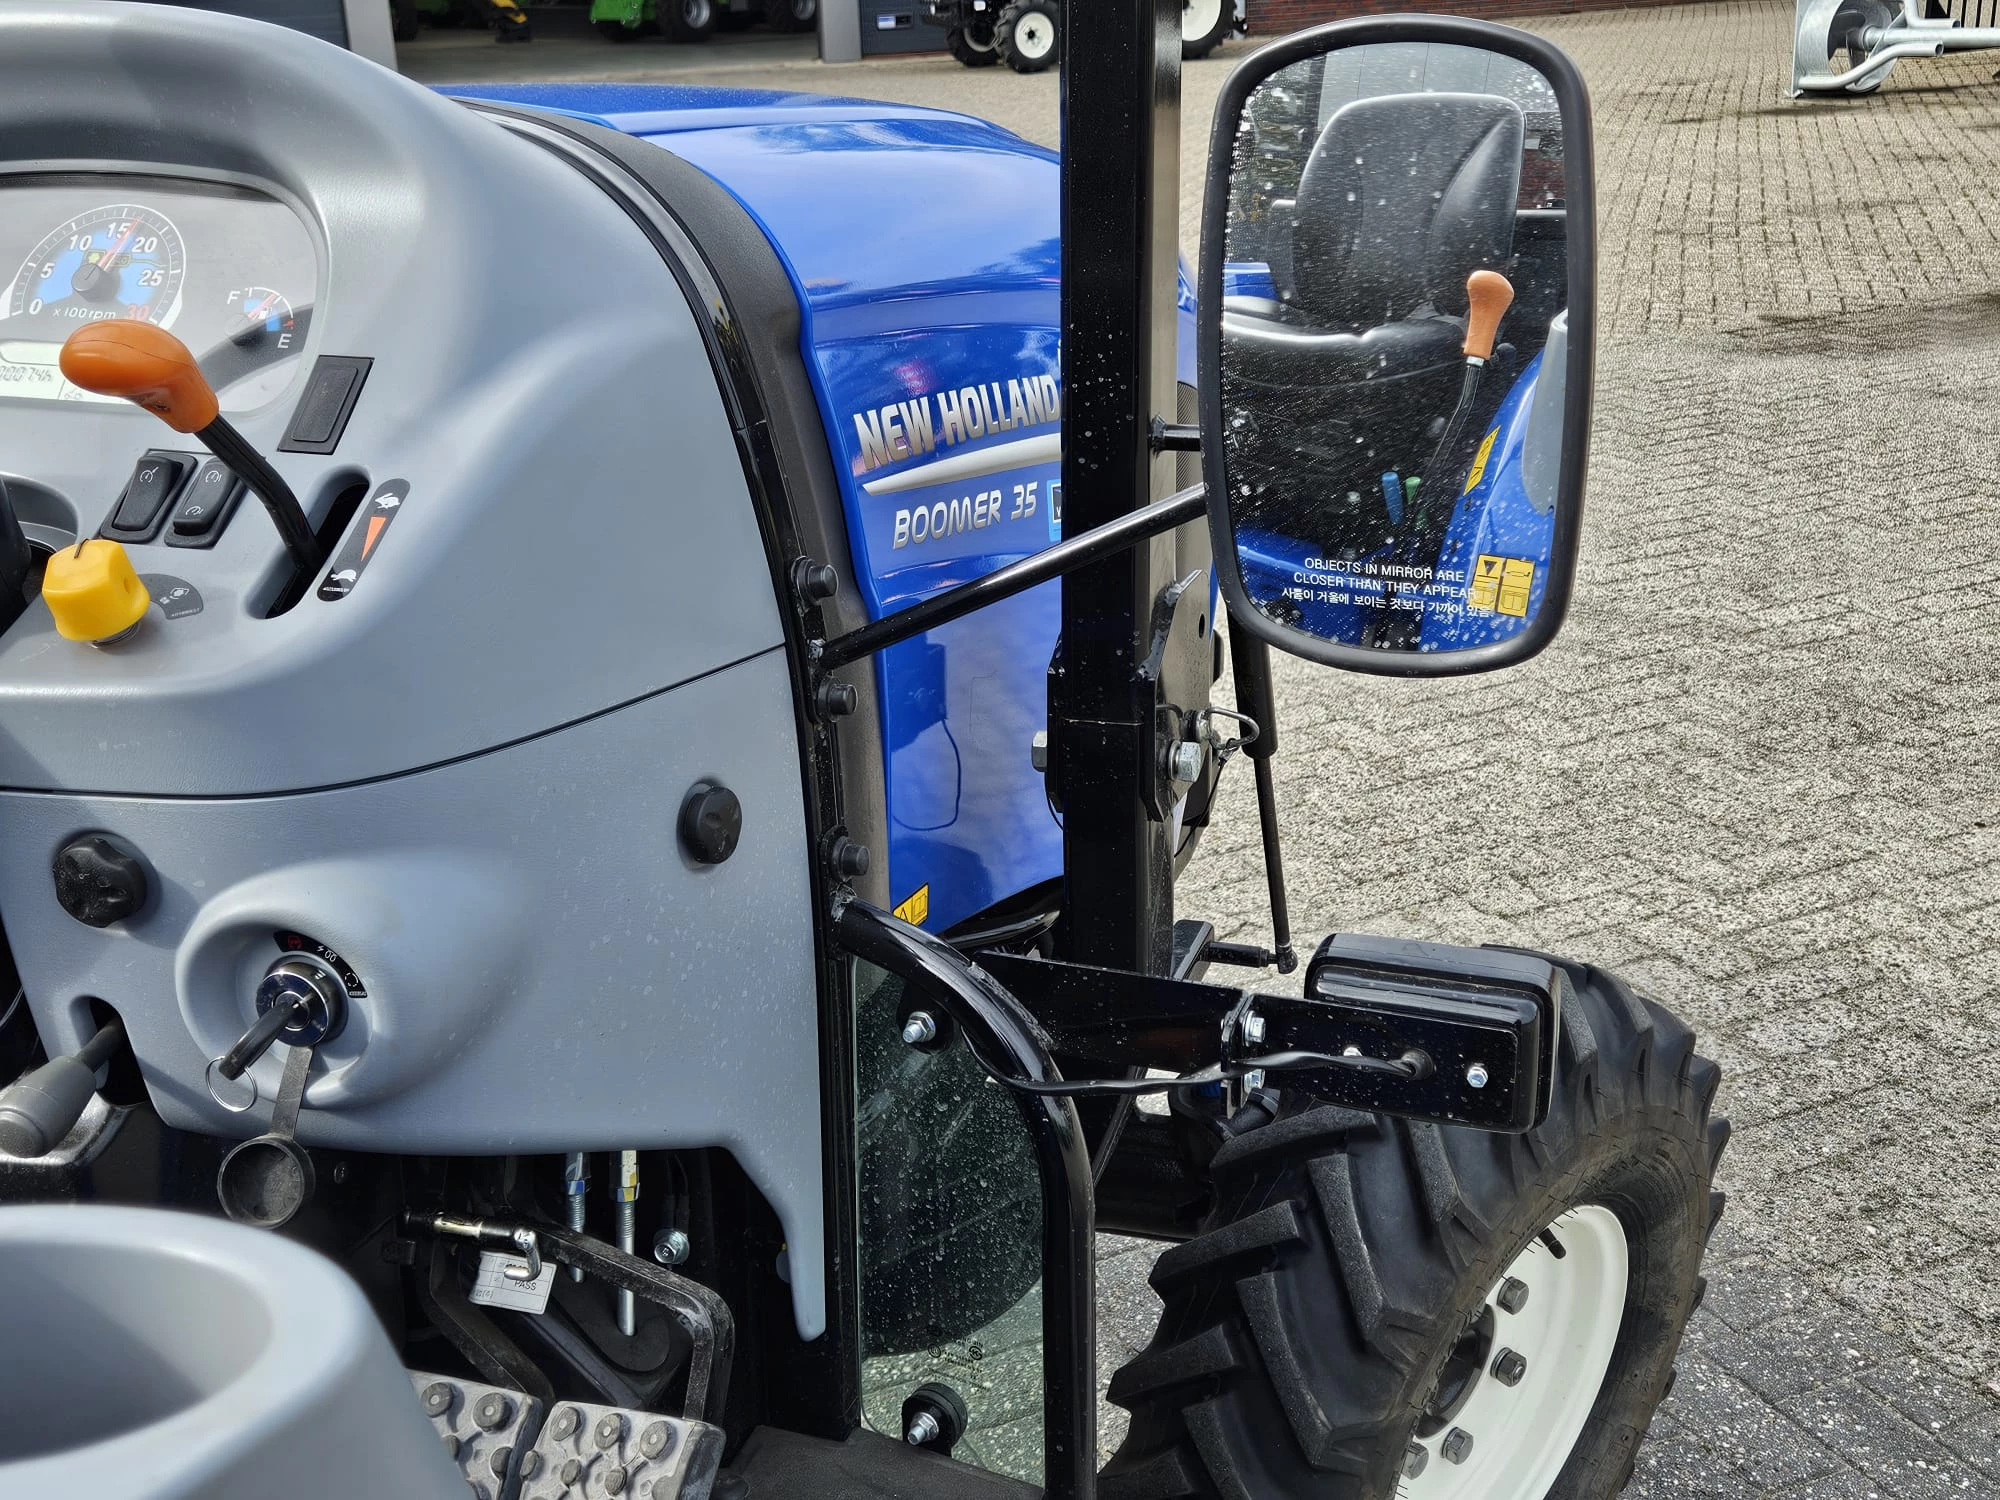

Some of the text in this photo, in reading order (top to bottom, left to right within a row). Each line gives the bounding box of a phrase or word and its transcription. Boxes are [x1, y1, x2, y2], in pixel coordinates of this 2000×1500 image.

[107, 222, 131, 239] 15
[70, 235, 92, 250] 10
[132, 237, 158, 253] 20
[40, 262, 55, 279] 5
[138, 270, 165, 286] 25
[227, 290, 240, 304] F
[29, 298, 43, 315] 0
[64, 307, 87, 318] 100
[88, 308, 116, 319] rpm
[127, 305, 150, 320] 30
[277, 333, 292, 349] E
[853, 374, 1061, 470] NEW HOLLAND
[892, 481, 1039, 550] BOOMER 35
[1304, 557, 1465, 583] OBJECTS IN MIRROR ARE
[1294, 572, 1477, 600] CLOSER THAN THEY APPEAR
[1317, 591, 1349, 605] 거울에
[1353, 594, 1386, 609] 보이는
[1390, 597, 1425, 612] 것보다
[515, 1280, 537, 1291] PASS
